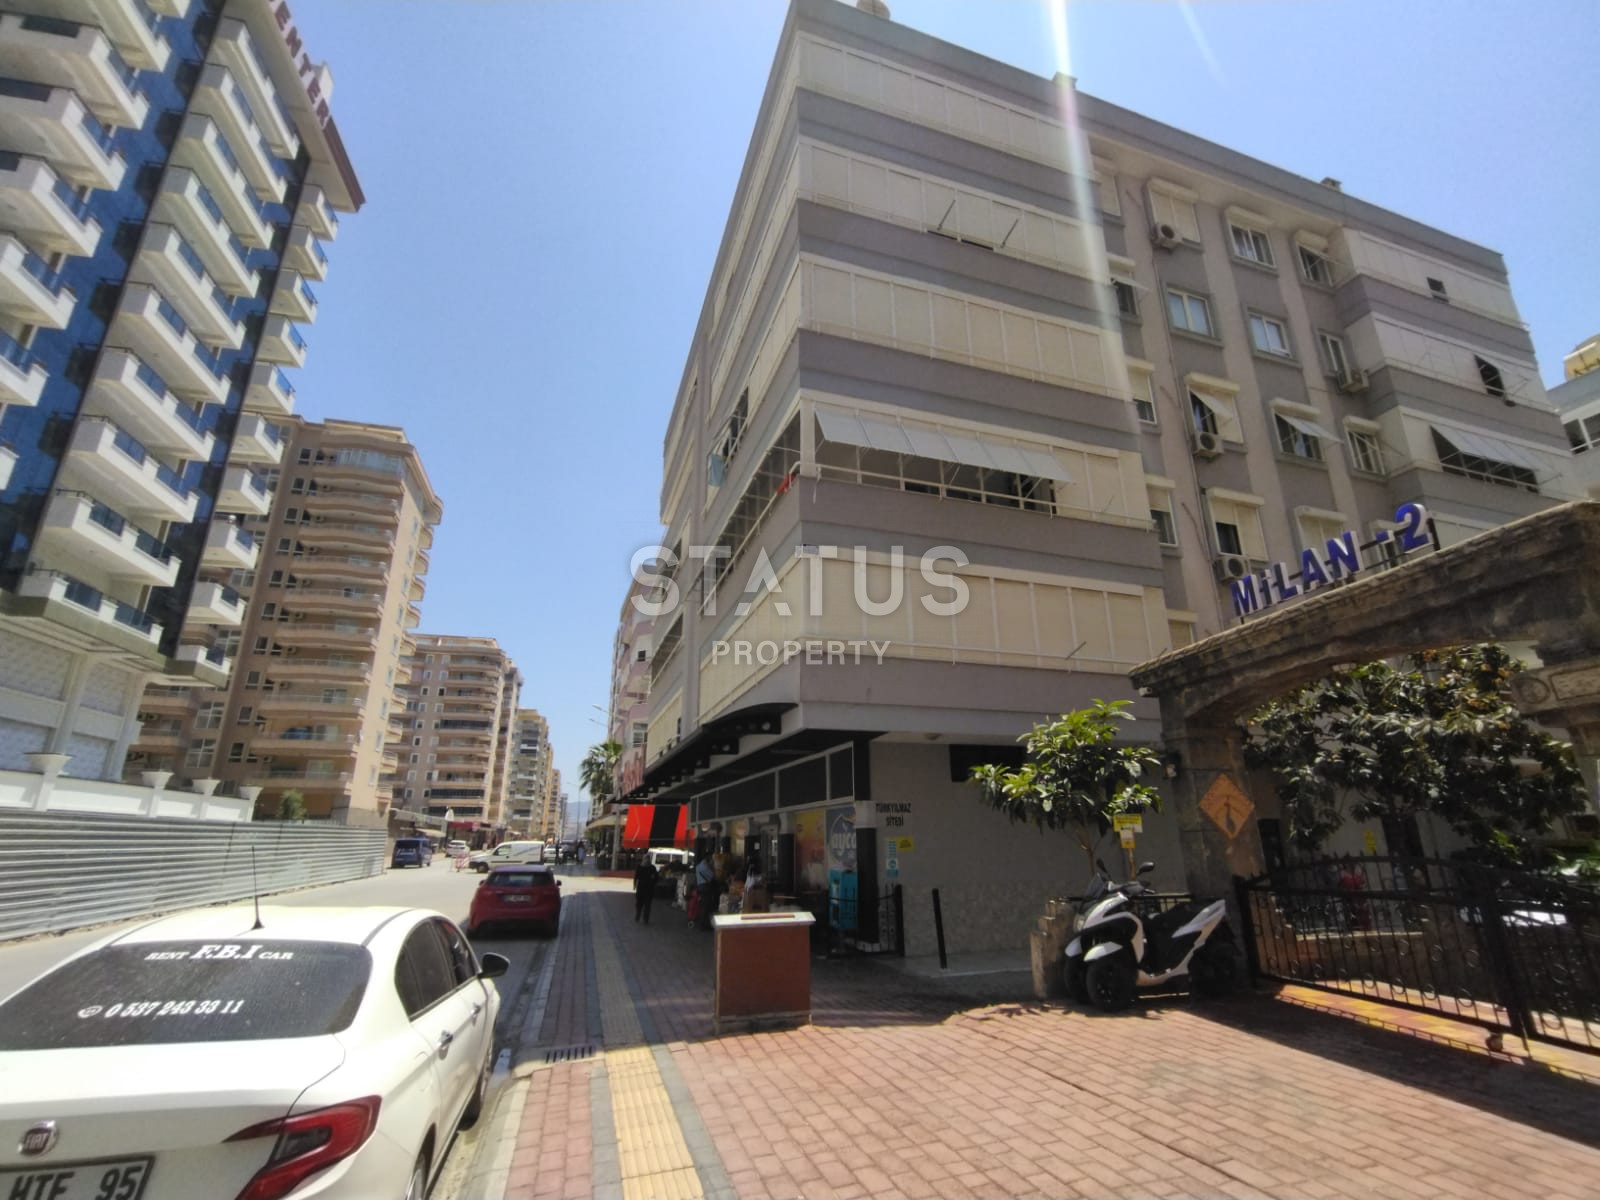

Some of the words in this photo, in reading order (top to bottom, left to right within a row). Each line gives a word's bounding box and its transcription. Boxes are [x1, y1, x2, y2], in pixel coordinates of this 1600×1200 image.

[270, 0, 330, 129] ENTER
[1394, 503, 1434, 554] 2
[144, 951, 190, 960] RENT
[258, 951, 294, 960] CAR
[220, 1000, 245, 1014] 11
[25, 1132, 50, 1150] FIAT
[95, 1165, 143, 1200] 95
